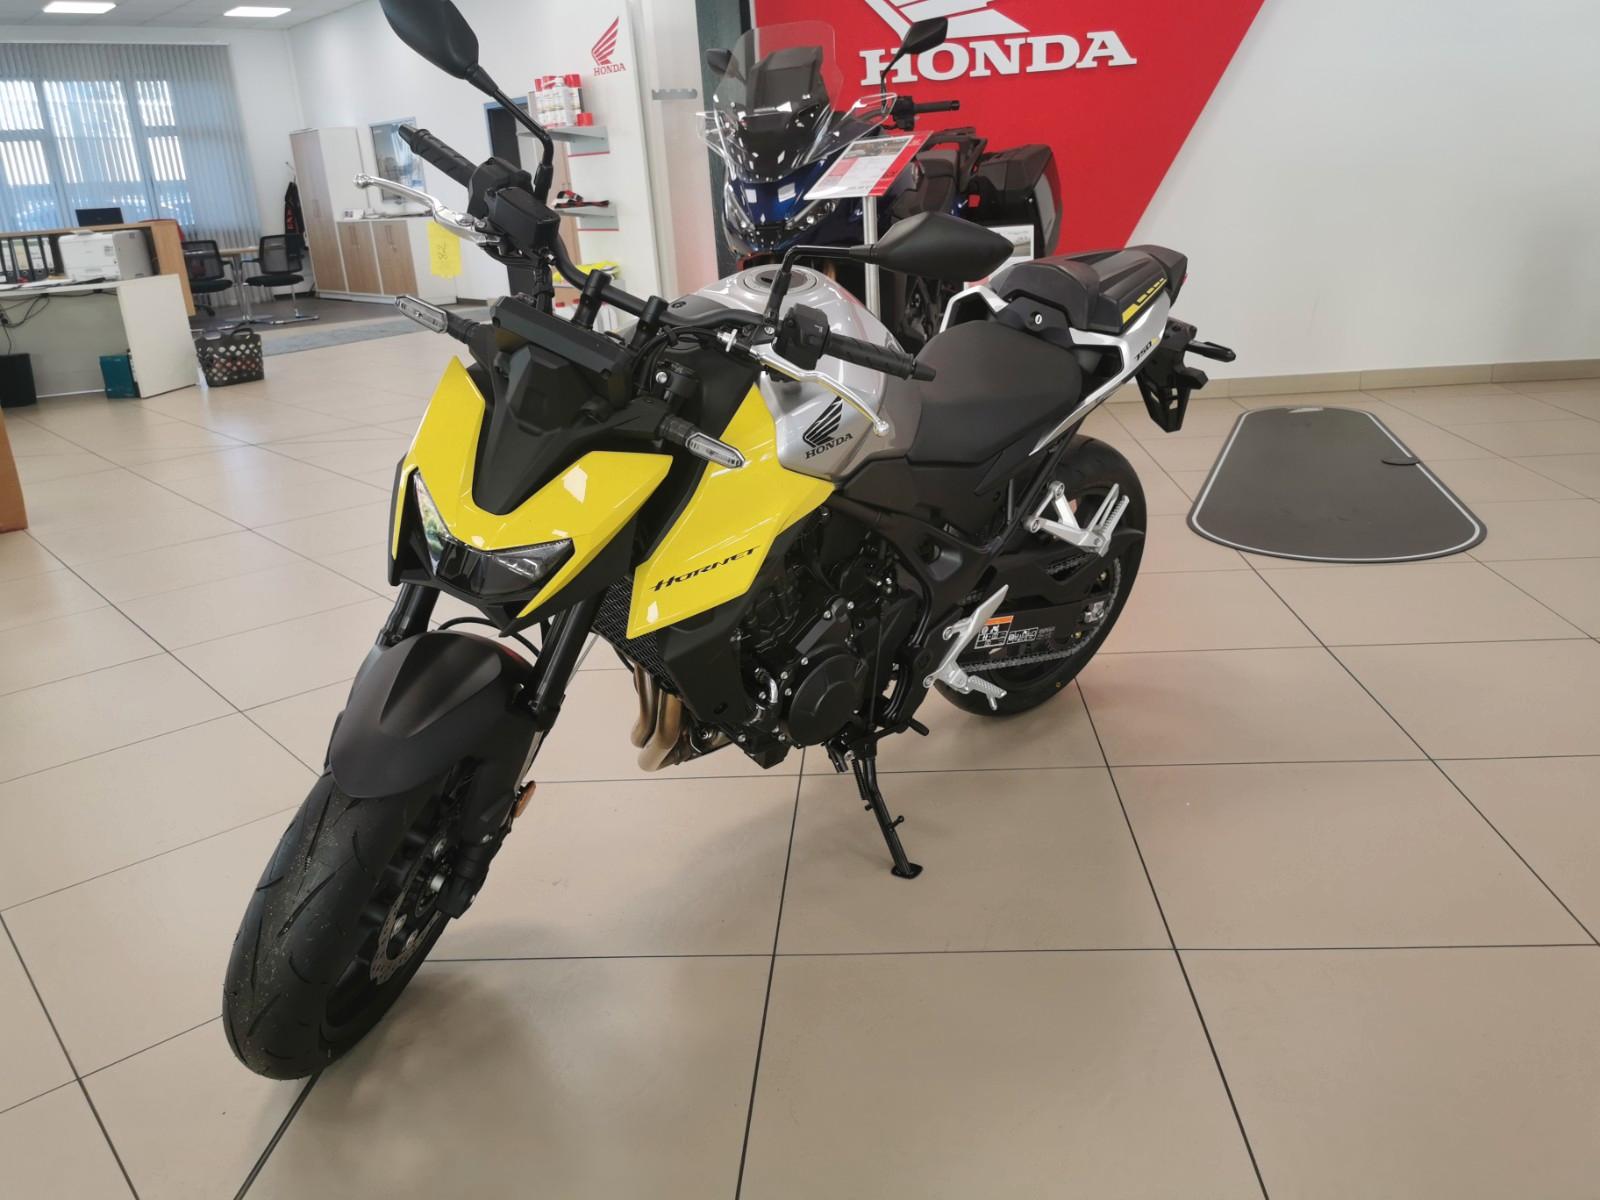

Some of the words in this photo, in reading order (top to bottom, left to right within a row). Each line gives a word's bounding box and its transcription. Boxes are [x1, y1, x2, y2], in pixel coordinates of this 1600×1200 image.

[594, 63, 626, 76] HONDA
[859, 31, 1137, 86] HONDA
[805, 433, 853, 460] HONDA
[647, 545, 761, 592] HORNET
